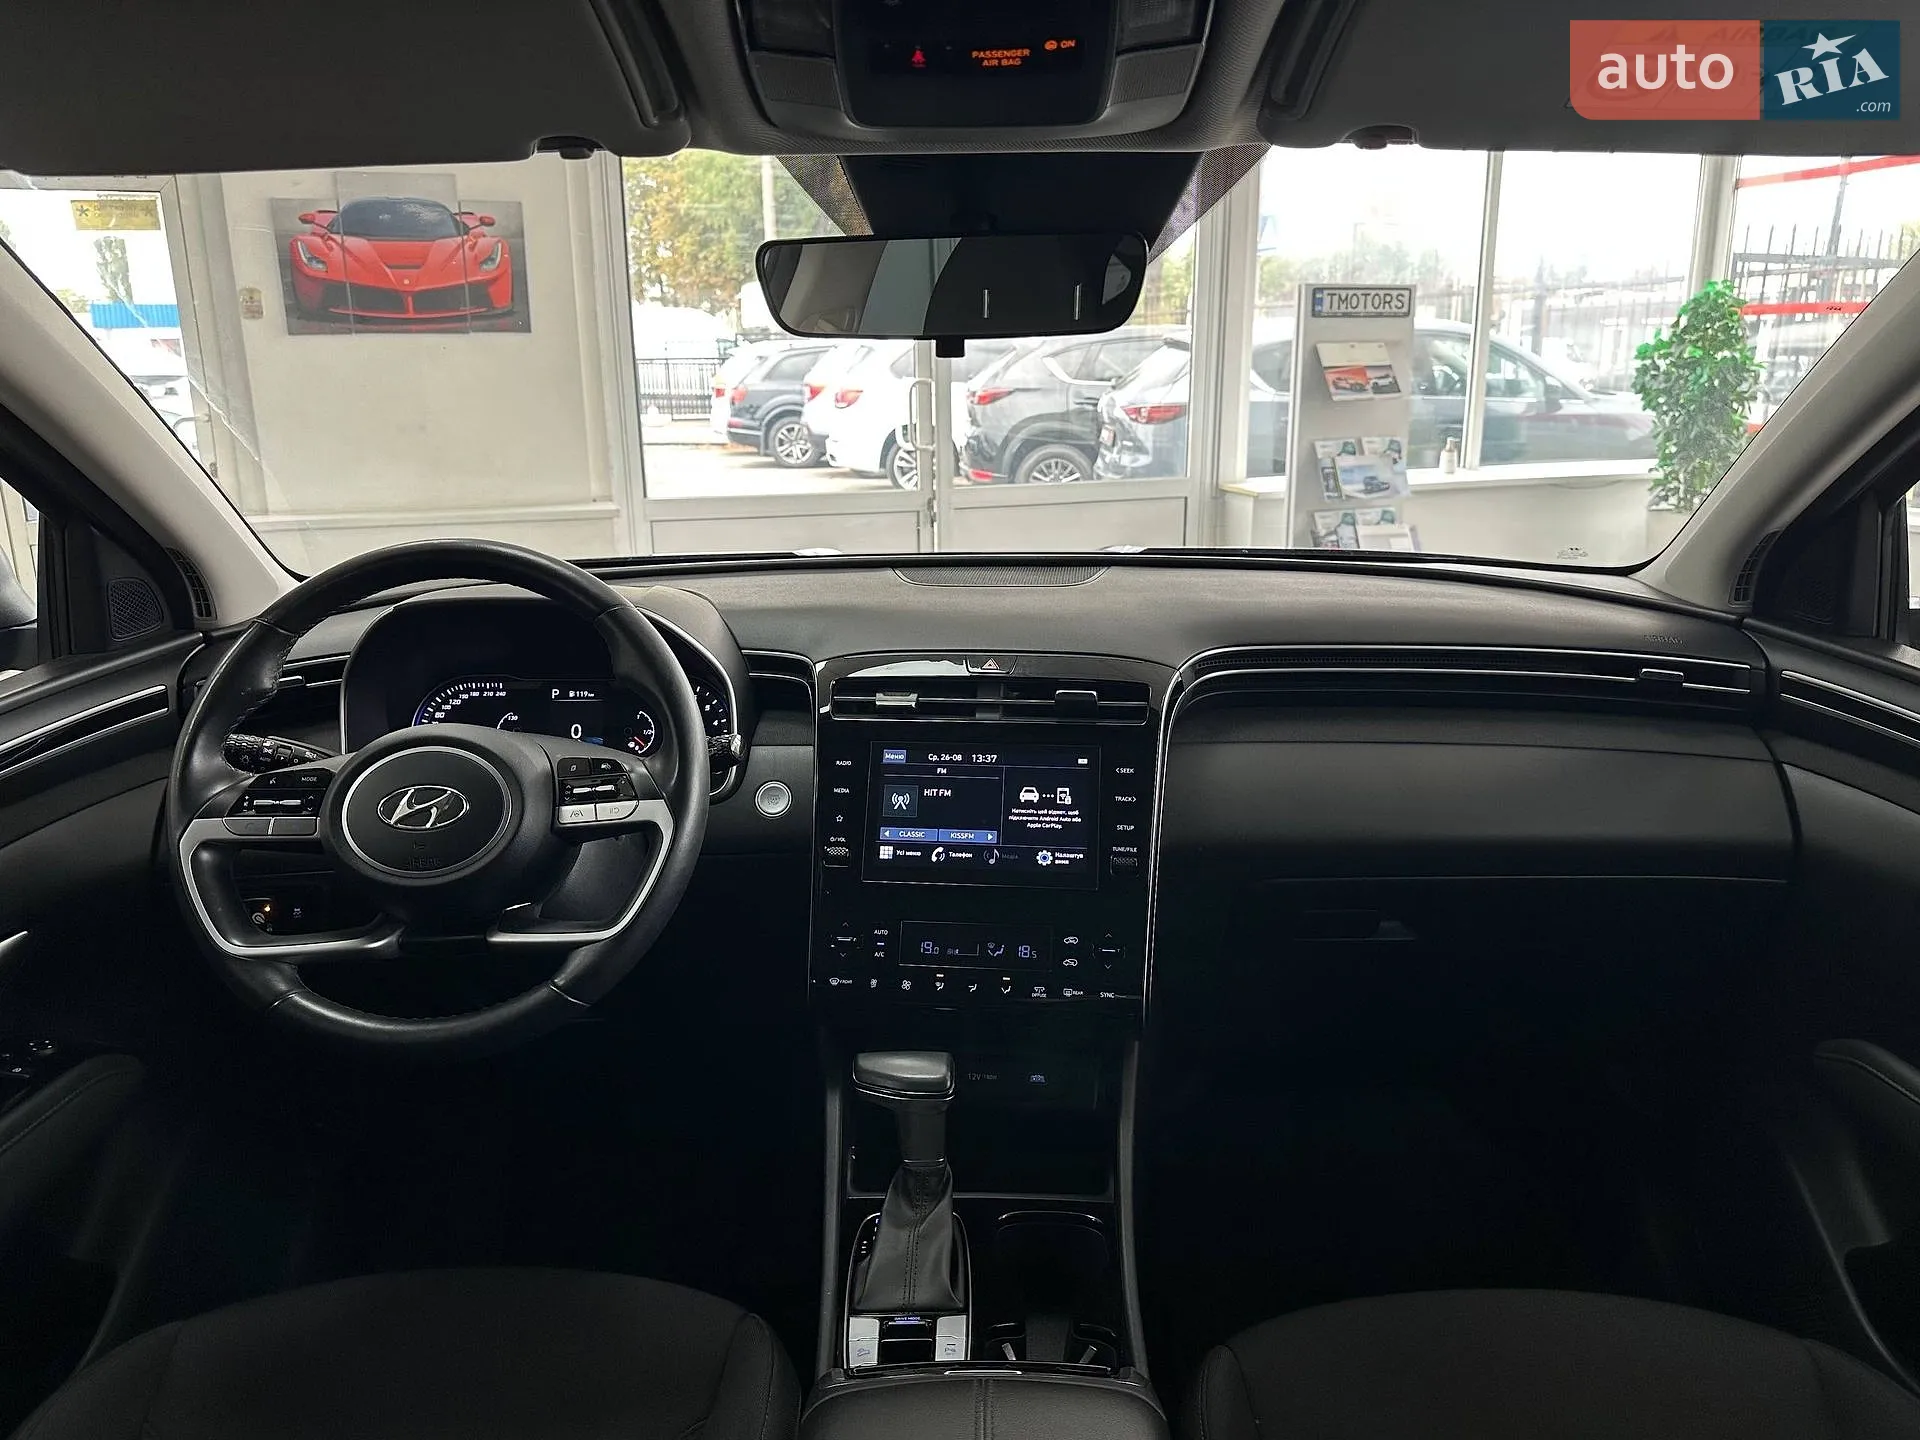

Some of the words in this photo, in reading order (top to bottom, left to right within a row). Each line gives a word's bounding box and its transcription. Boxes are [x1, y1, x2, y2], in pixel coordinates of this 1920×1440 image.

[1060, 39, 1076, 48] ON
[971, 48, 1031, 59] PASSENGER
[982, 58, 999, 66] AIR
[1001, 57, 1022, 66] BAG
[1327, 292, 1405, 310] TMOTORS
[551, 688, 560, 699] P
[576, 690, 589, 698] 119
[570, 723, 582, 739] 0
[884, 752, 905, 760] Меню
[928, 753, 940, 762] Ср.
[971, 754, 998, 763] 13:37
[924, 788, 938, 797] HIT
[938, 789, 952, 797] FM
[898, 830, 925, 838] CLASSIC
[950, 832, 975, 840] KISSFM
[949, 851, 973, 859] Телефон
